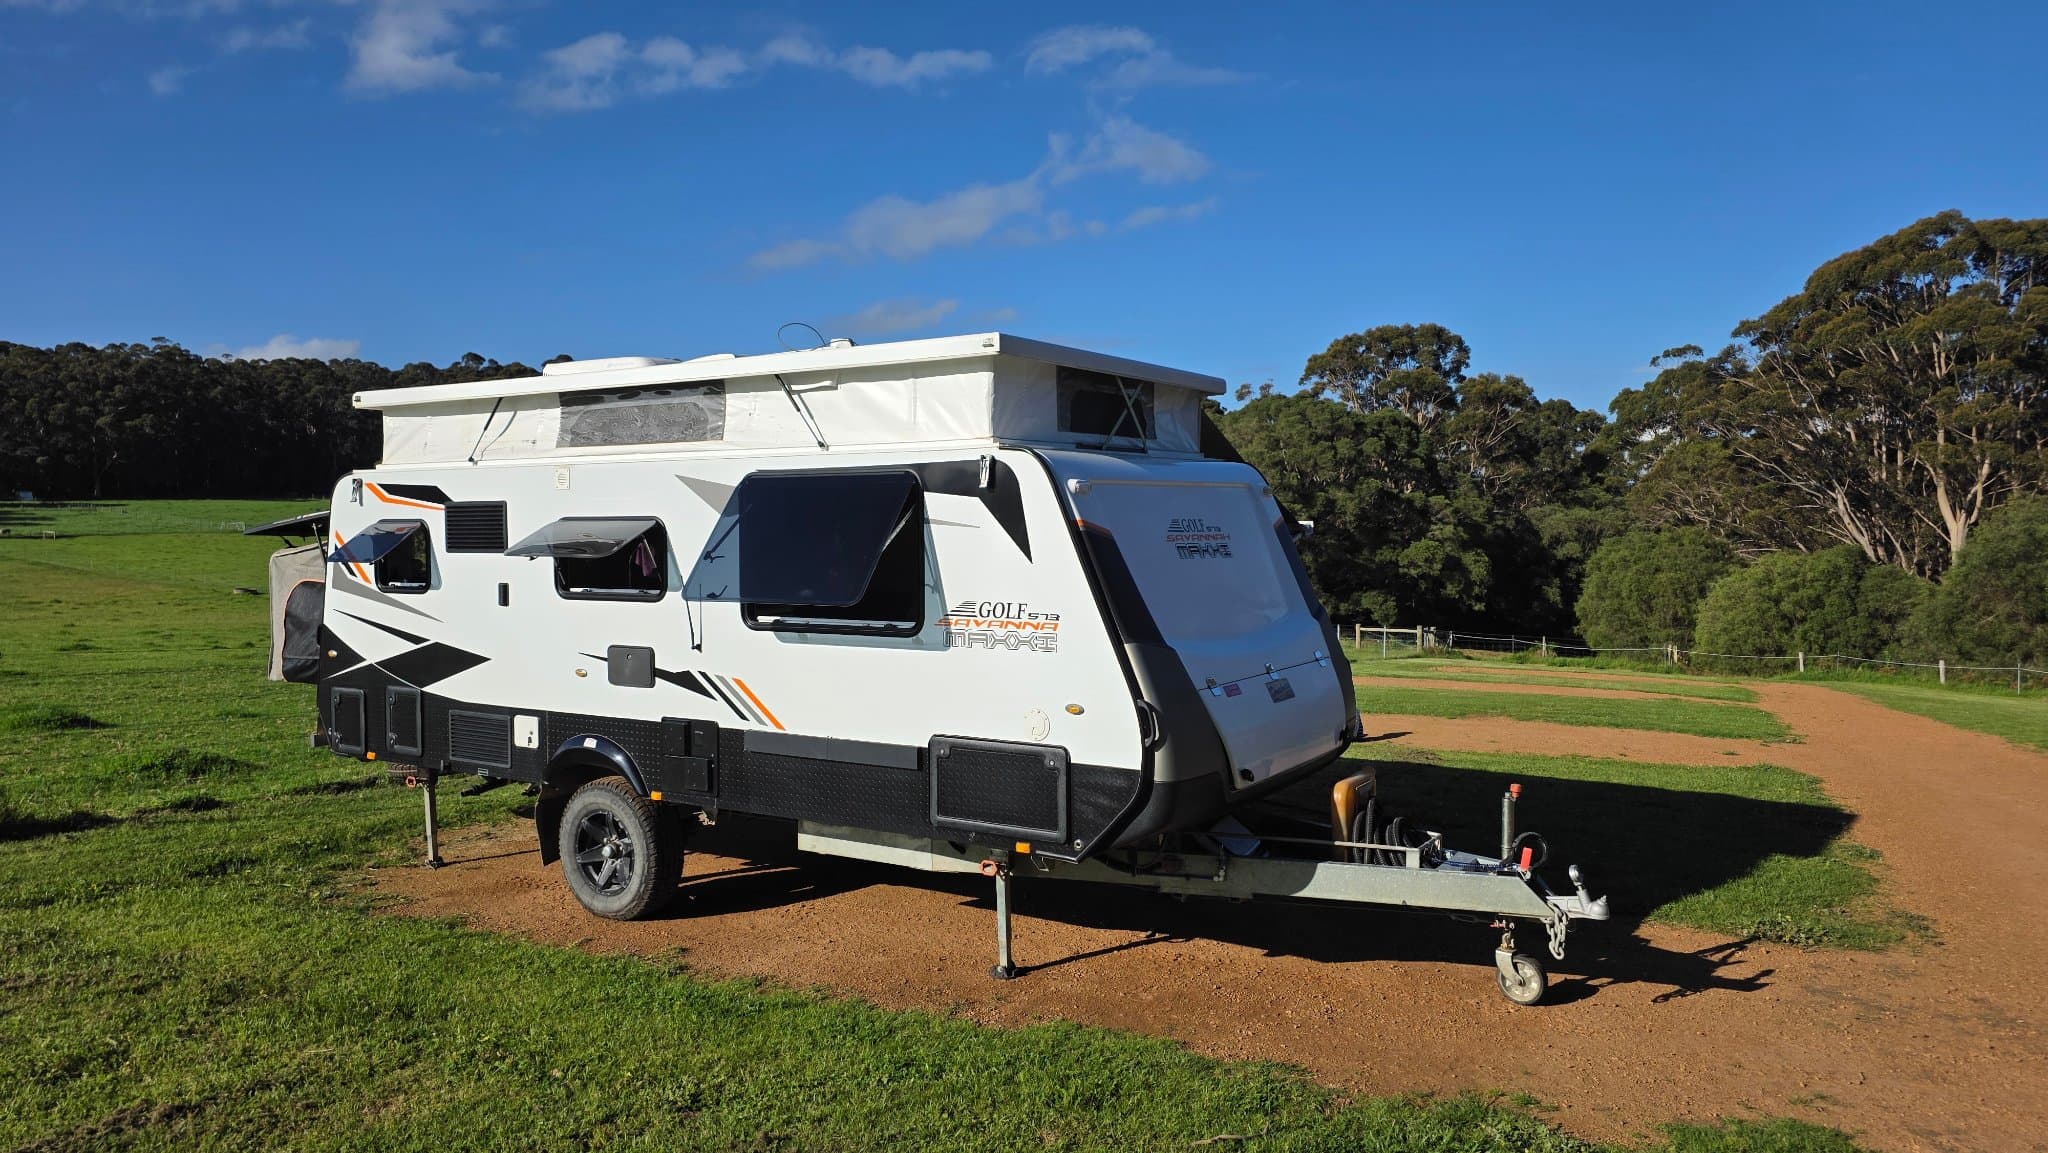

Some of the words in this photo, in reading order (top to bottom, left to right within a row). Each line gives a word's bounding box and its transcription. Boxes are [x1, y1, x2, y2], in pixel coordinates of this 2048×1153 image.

[1181, 518, 1205, 532] GOLF
[978, 601, 1027, 619] GOLF
[1028, 612, 1060, 621] 573
[934, 618, 1059, 631] SAVANNA
[943, 628, 1057, 652] MAXXI
